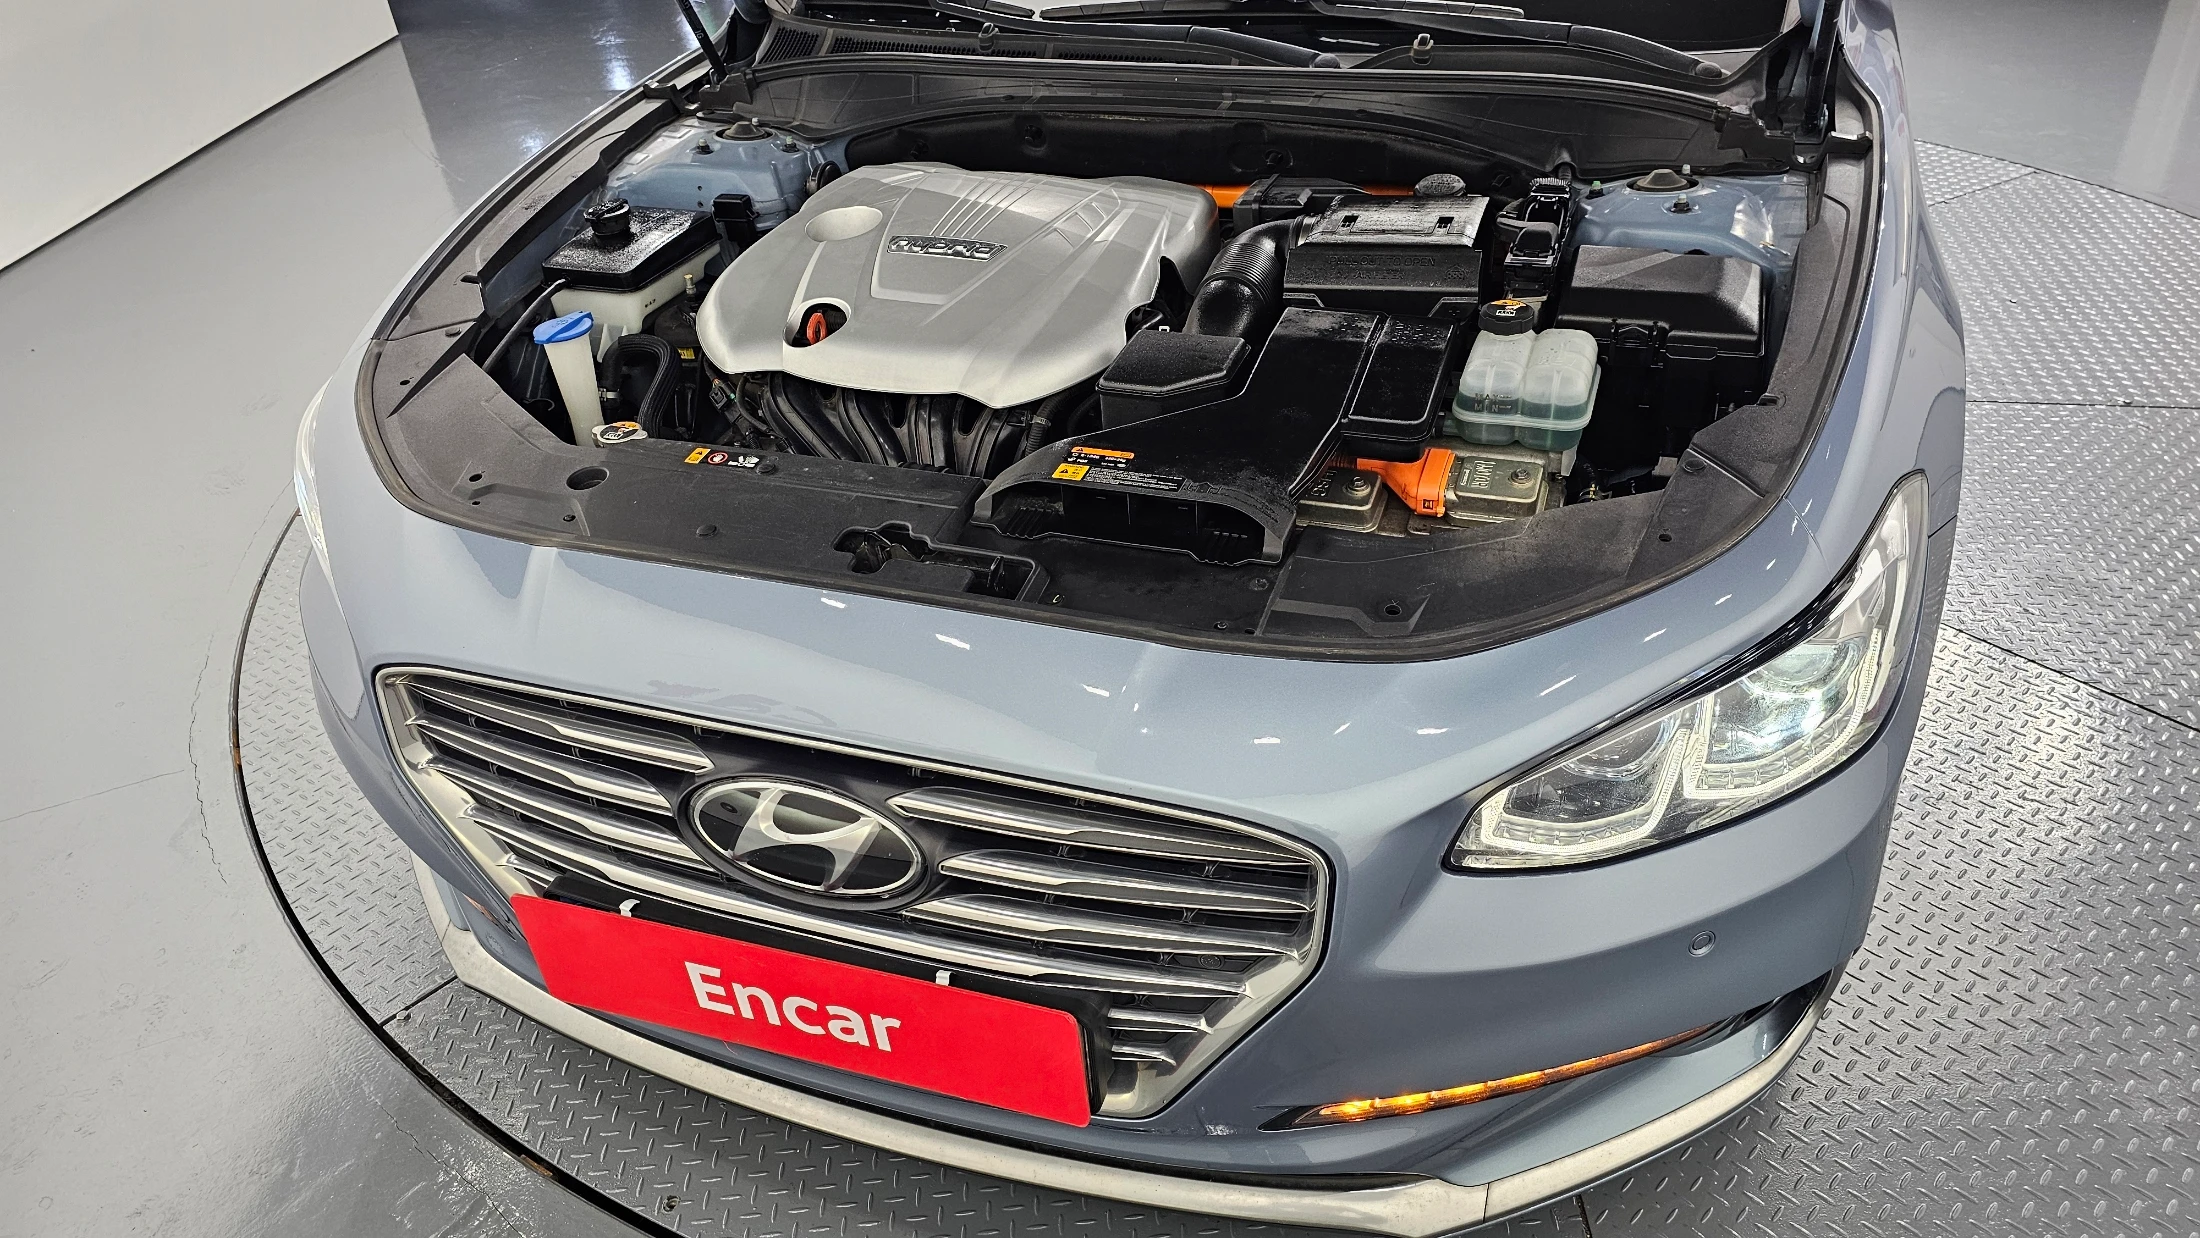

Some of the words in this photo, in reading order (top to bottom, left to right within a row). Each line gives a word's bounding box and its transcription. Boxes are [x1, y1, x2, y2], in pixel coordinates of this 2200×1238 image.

[1328, 255, 1358, 266] PULL
[1361, 256, 1383, 267] OUT
[1386, 256, 1401, 267] TO
[1404, 256, 1436, 267] OPEN
[1354, 270, 1371, 280] AIR
[684, 961, 902, 1052] Encar
